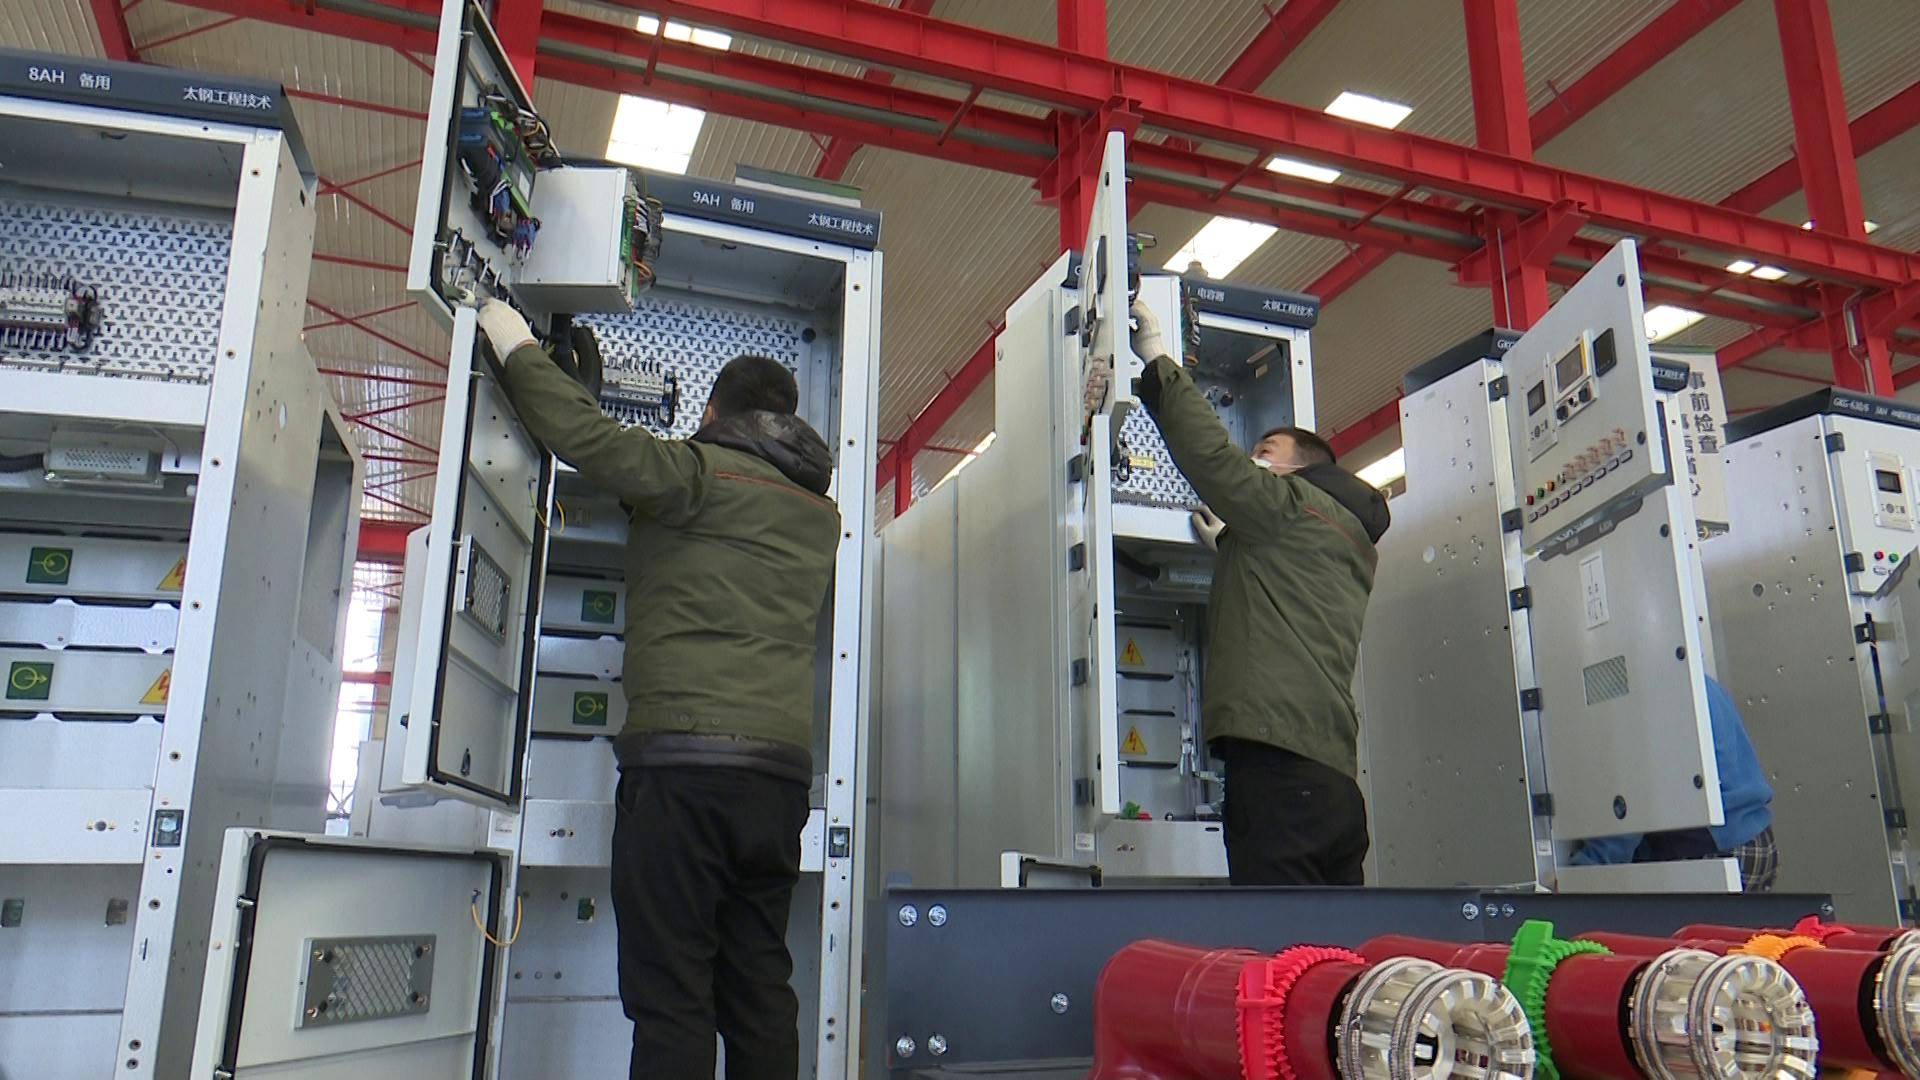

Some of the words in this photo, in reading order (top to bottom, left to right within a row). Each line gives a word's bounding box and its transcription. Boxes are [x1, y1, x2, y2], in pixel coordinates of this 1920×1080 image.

[28, 67, 64, 84] 8AH
[79, 73, 111, 90] 备用
[183, 87, 272, 109] 太钢工程技术
[692, 191, 720, 207] 9AH
[731, 198, 754, 213] 备用
[807, 213, 873, 235] 太钢工程技术
